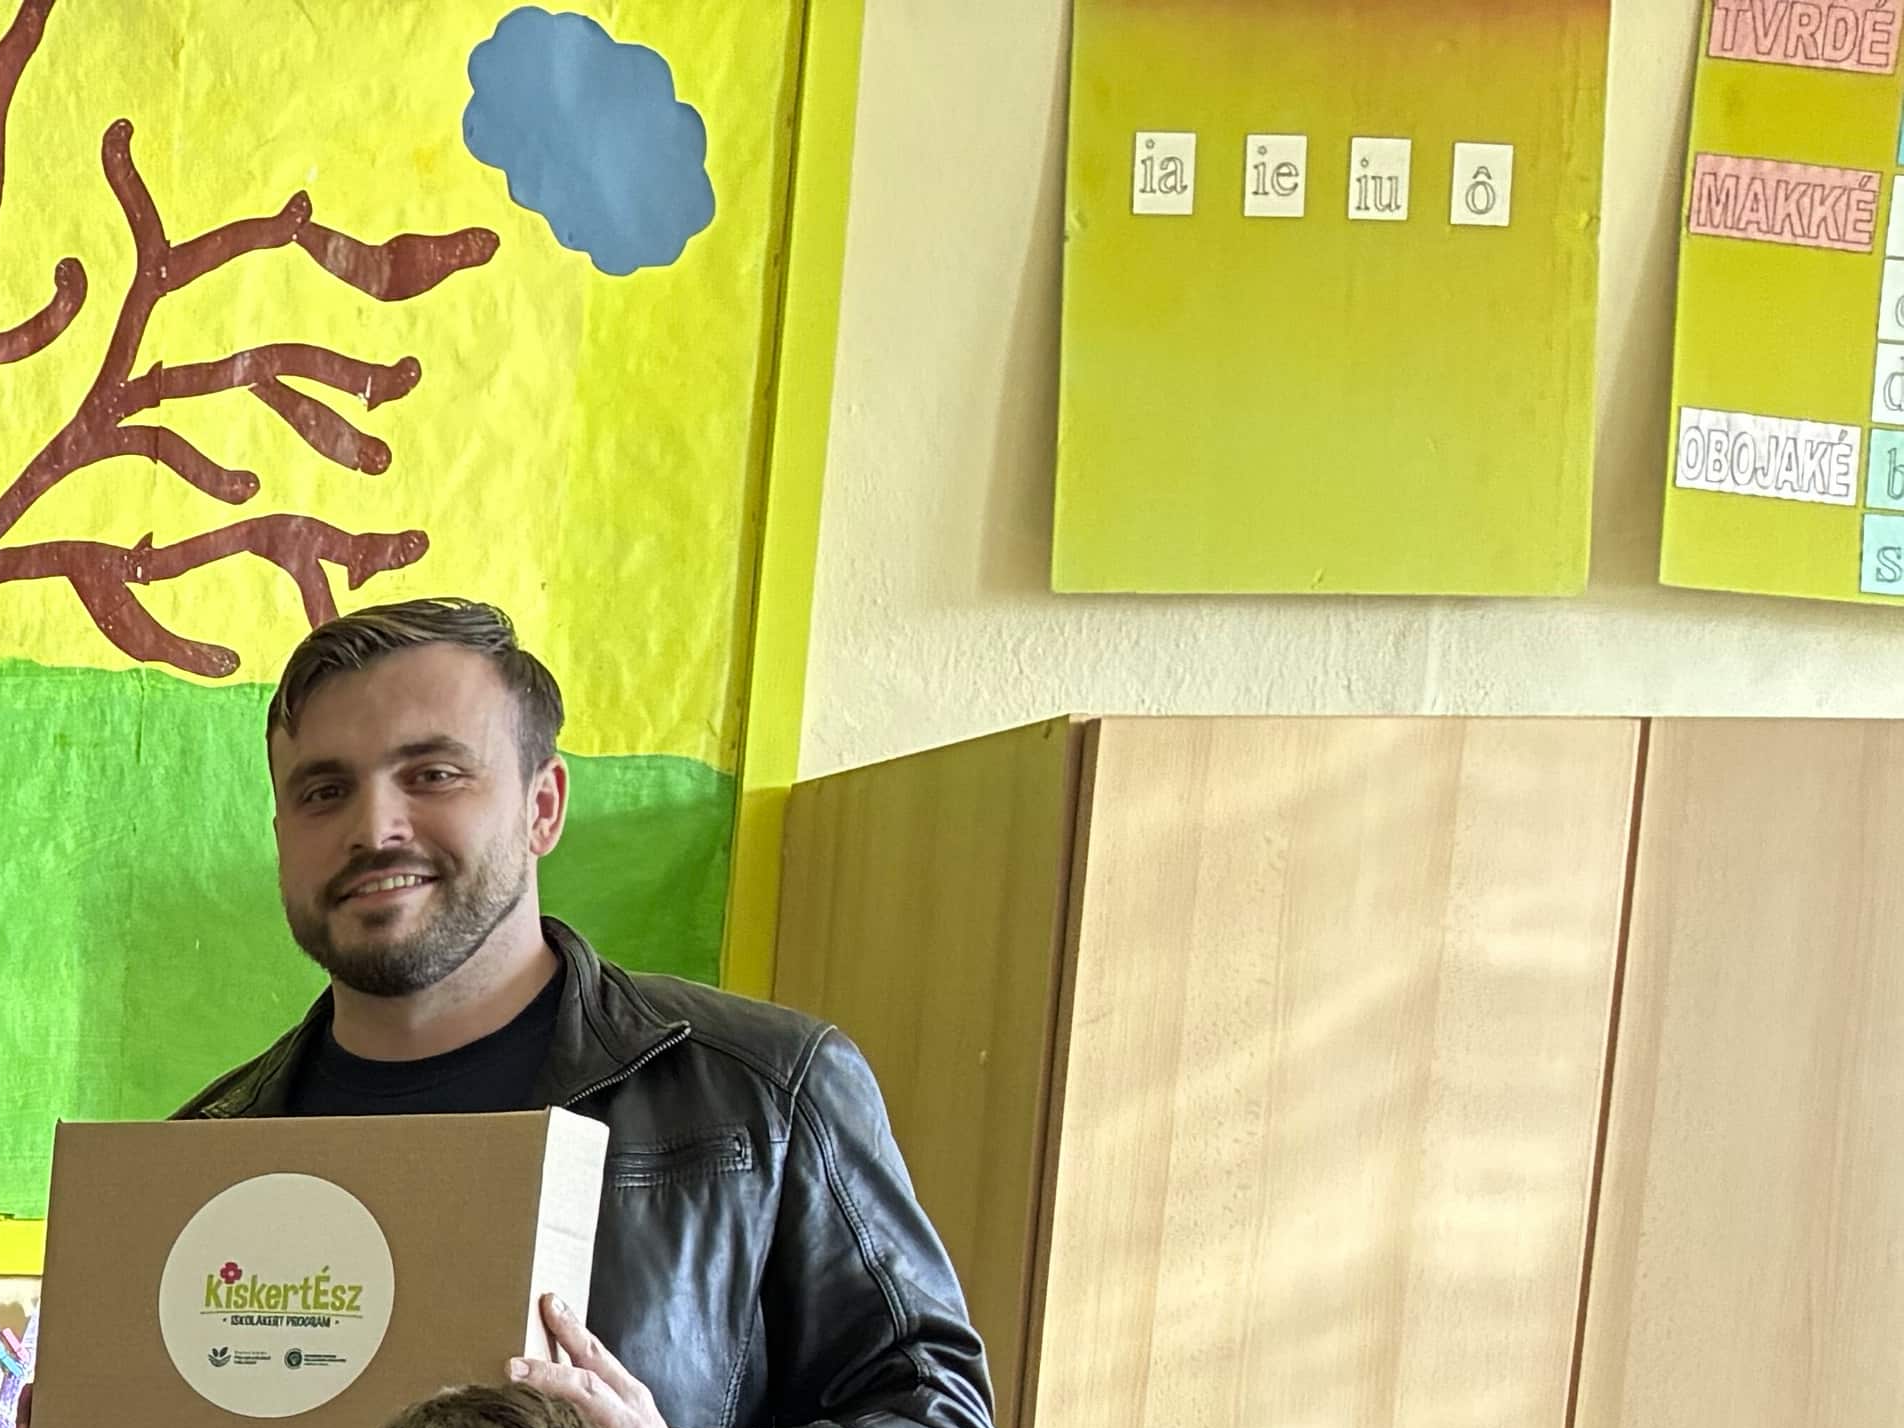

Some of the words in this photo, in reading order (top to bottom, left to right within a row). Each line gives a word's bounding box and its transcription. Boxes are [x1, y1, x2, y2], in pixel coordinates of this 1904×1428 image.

[1141, 140, 1189, 197] ia
[1253, 145, 1299, 197] ie
[1356, 159, 1402, 212] iu
[1466, 168, 1498, 216] ô
[1695, 172, 1878, 244] MAKKÉ
[1680, 425, 1853, 497] OBOJAKÉ
[205, 1265, 364, 1312] KiskertÉsz
